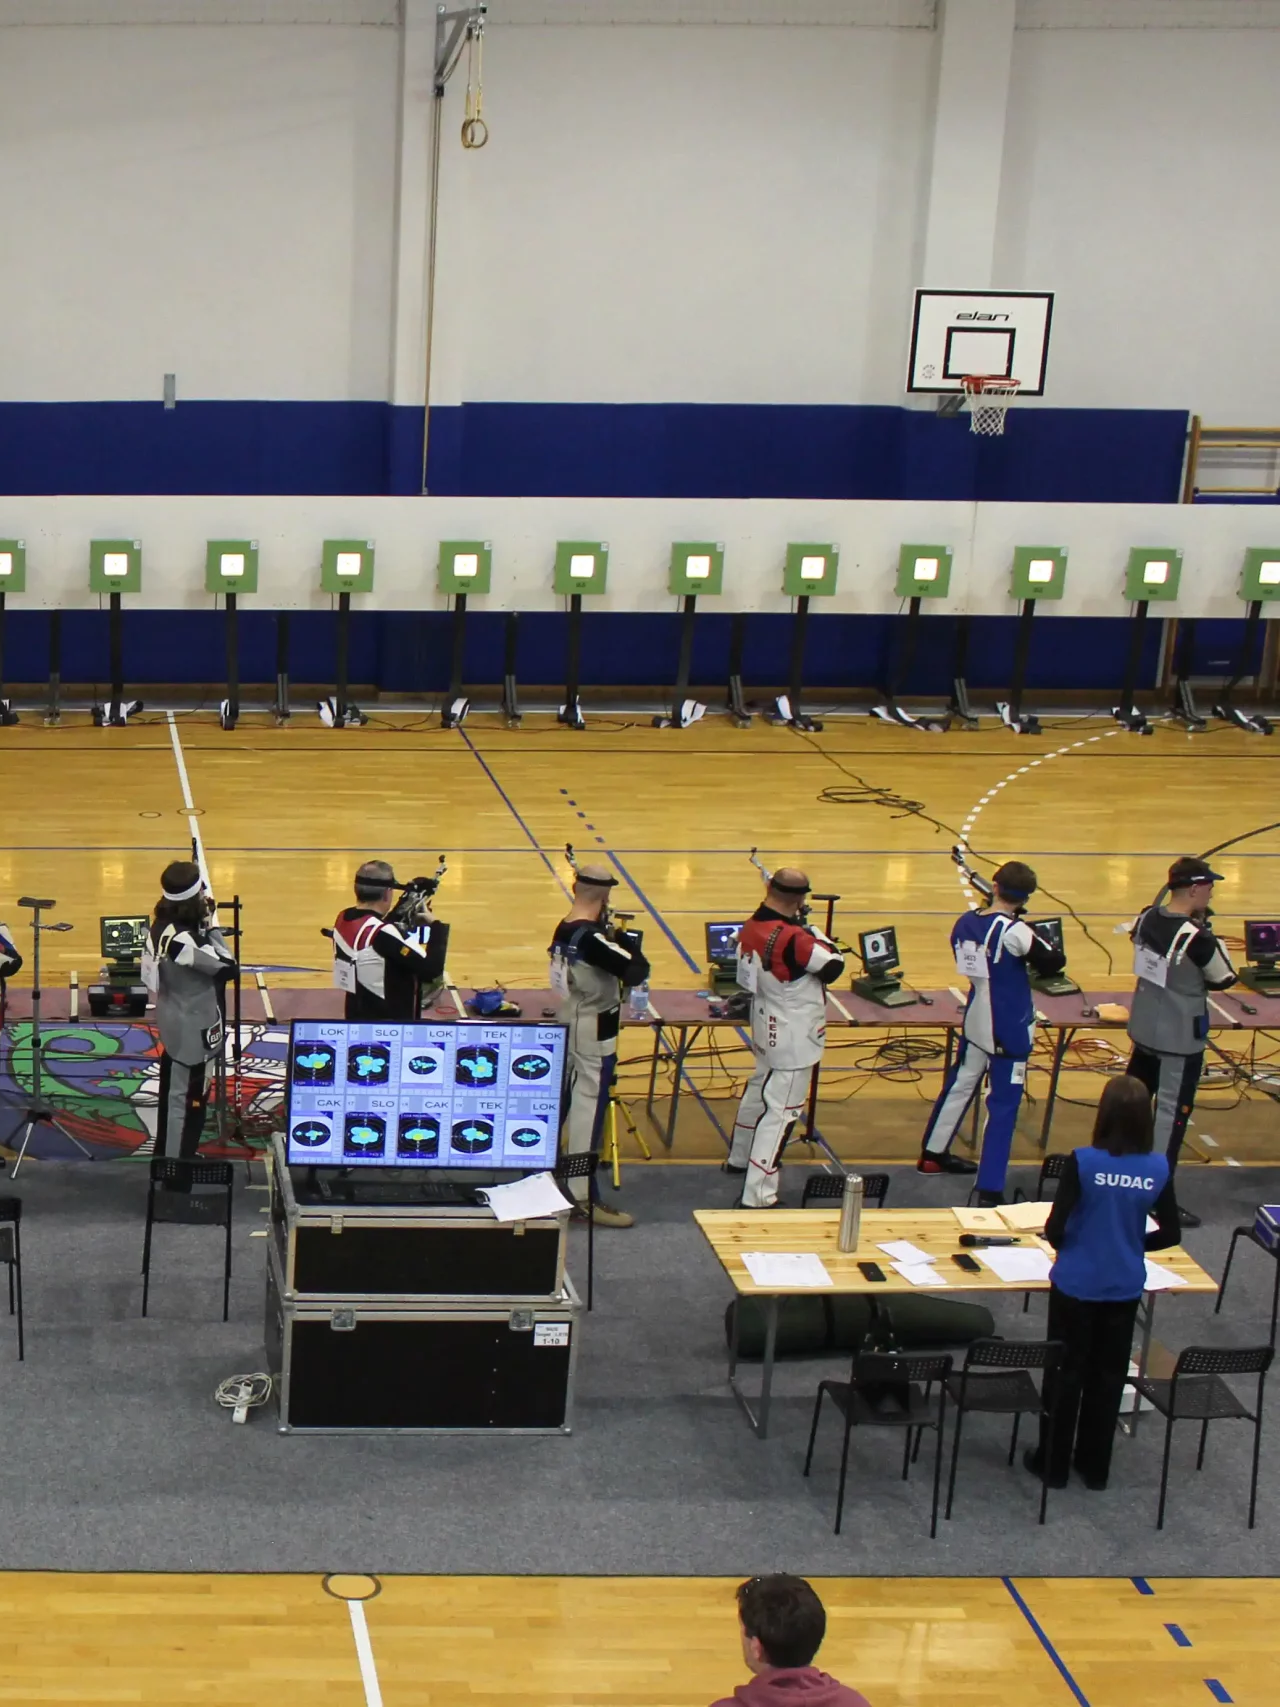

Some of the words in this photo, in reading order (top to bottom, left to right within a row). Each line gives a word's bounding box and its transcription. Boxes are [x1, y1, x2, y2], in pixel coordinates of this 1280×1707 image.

[956, 311, 1009, 321] elan
[320, 1028, 344, 1036] LOK
[374, 1029, 399, 1037] SLO
[429, 1030, 453, 1038] LOK
[483, 1030, 508, 1038] TEK
[538, 1032, 563, 1040] LOK
[317, 1099, 342, 1107] CAK
[371, 1099, 395, 1108] SLO
[424, 1100, 449, 1108] CAK
[479, 1101, 503, 1109] TEK
[532, 1102, 557, 1111] LOK
[1094, 1172, 1154, 1190] SUDAC
